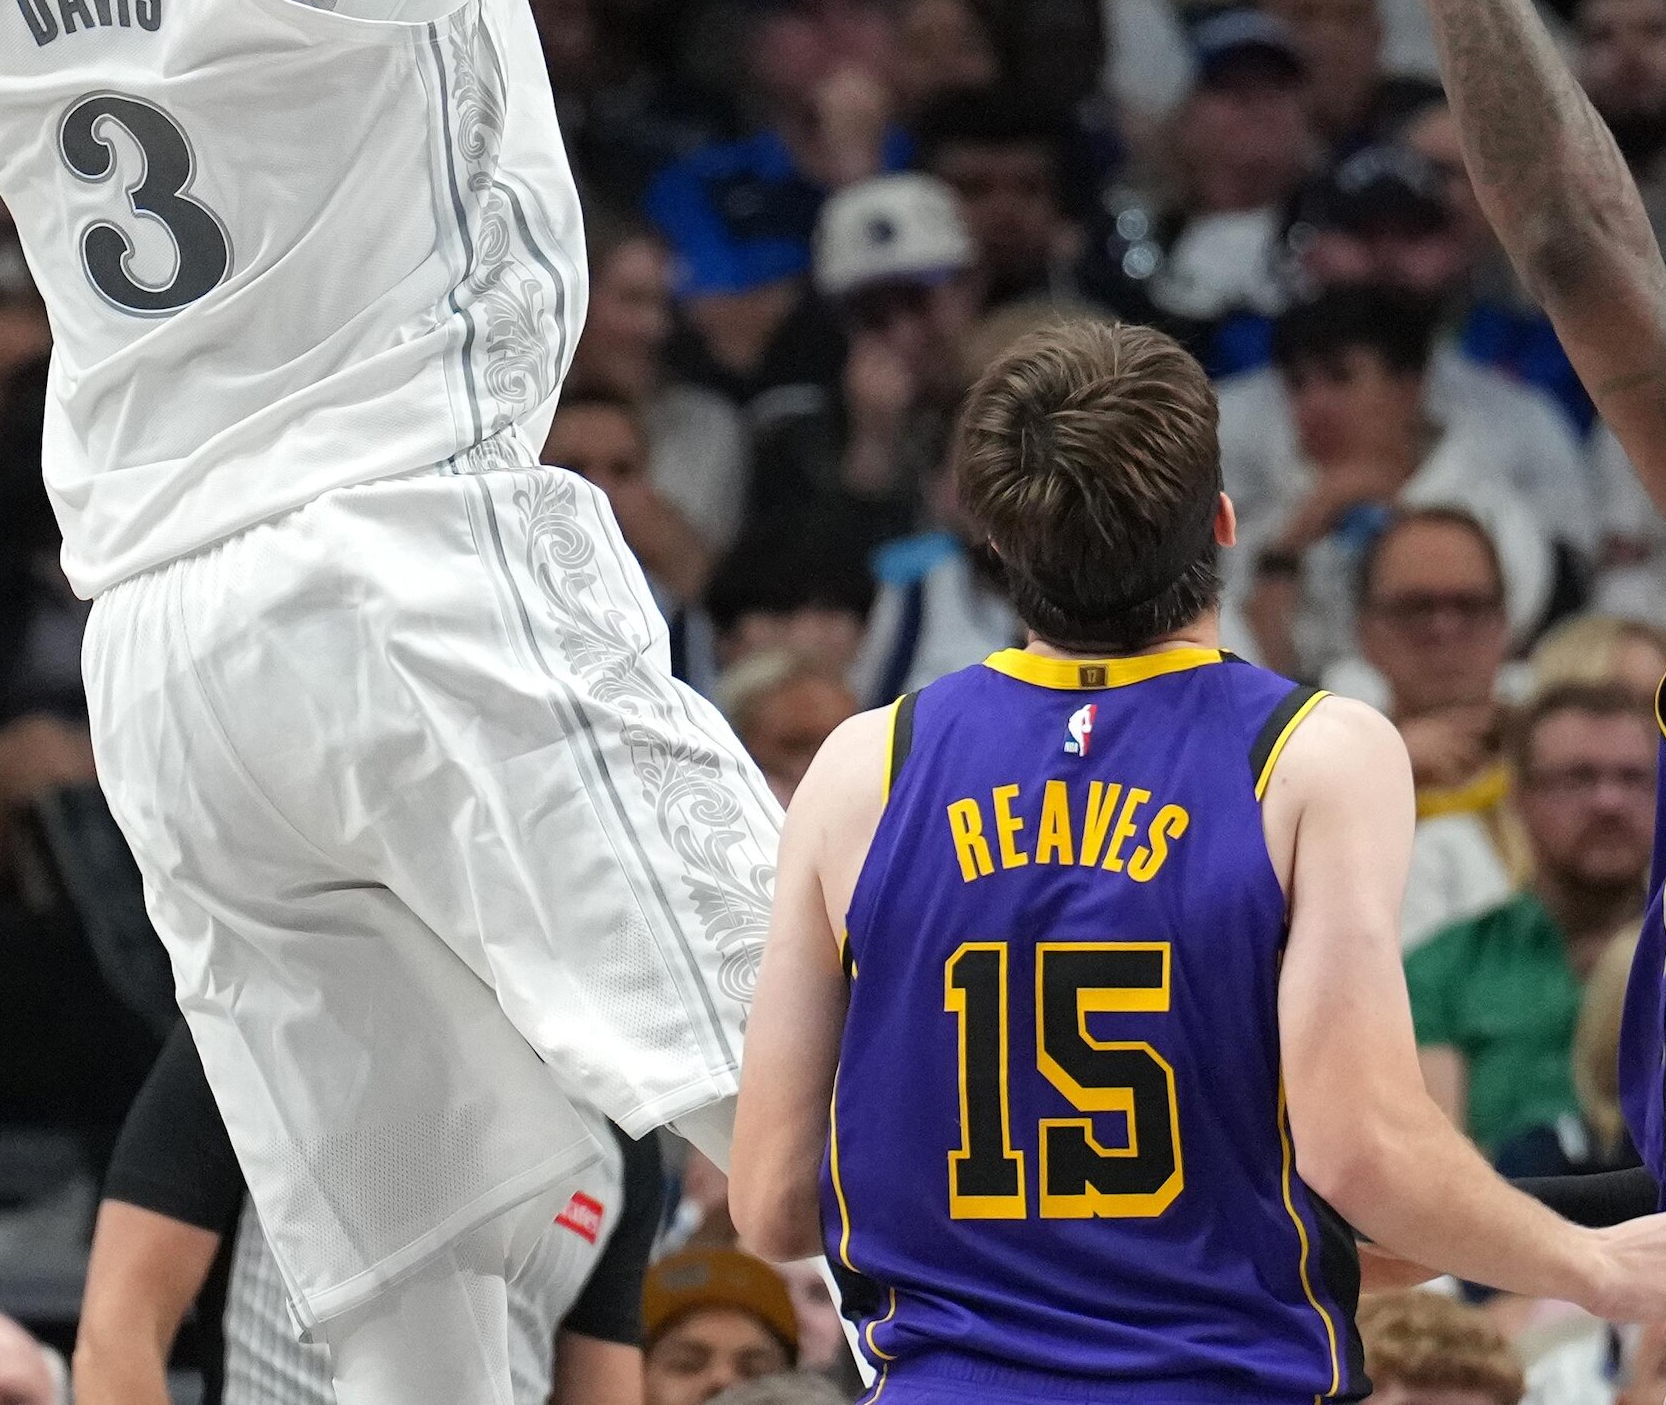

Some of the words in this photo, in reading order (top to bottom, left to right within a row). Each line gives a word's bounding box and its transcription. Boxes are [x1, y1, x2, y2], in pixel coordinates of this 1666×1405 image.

[56, 89, 234, 319] 3
[946, 780, 1190, 883] REAVES
[944, 941, 1185, 1219] 15
